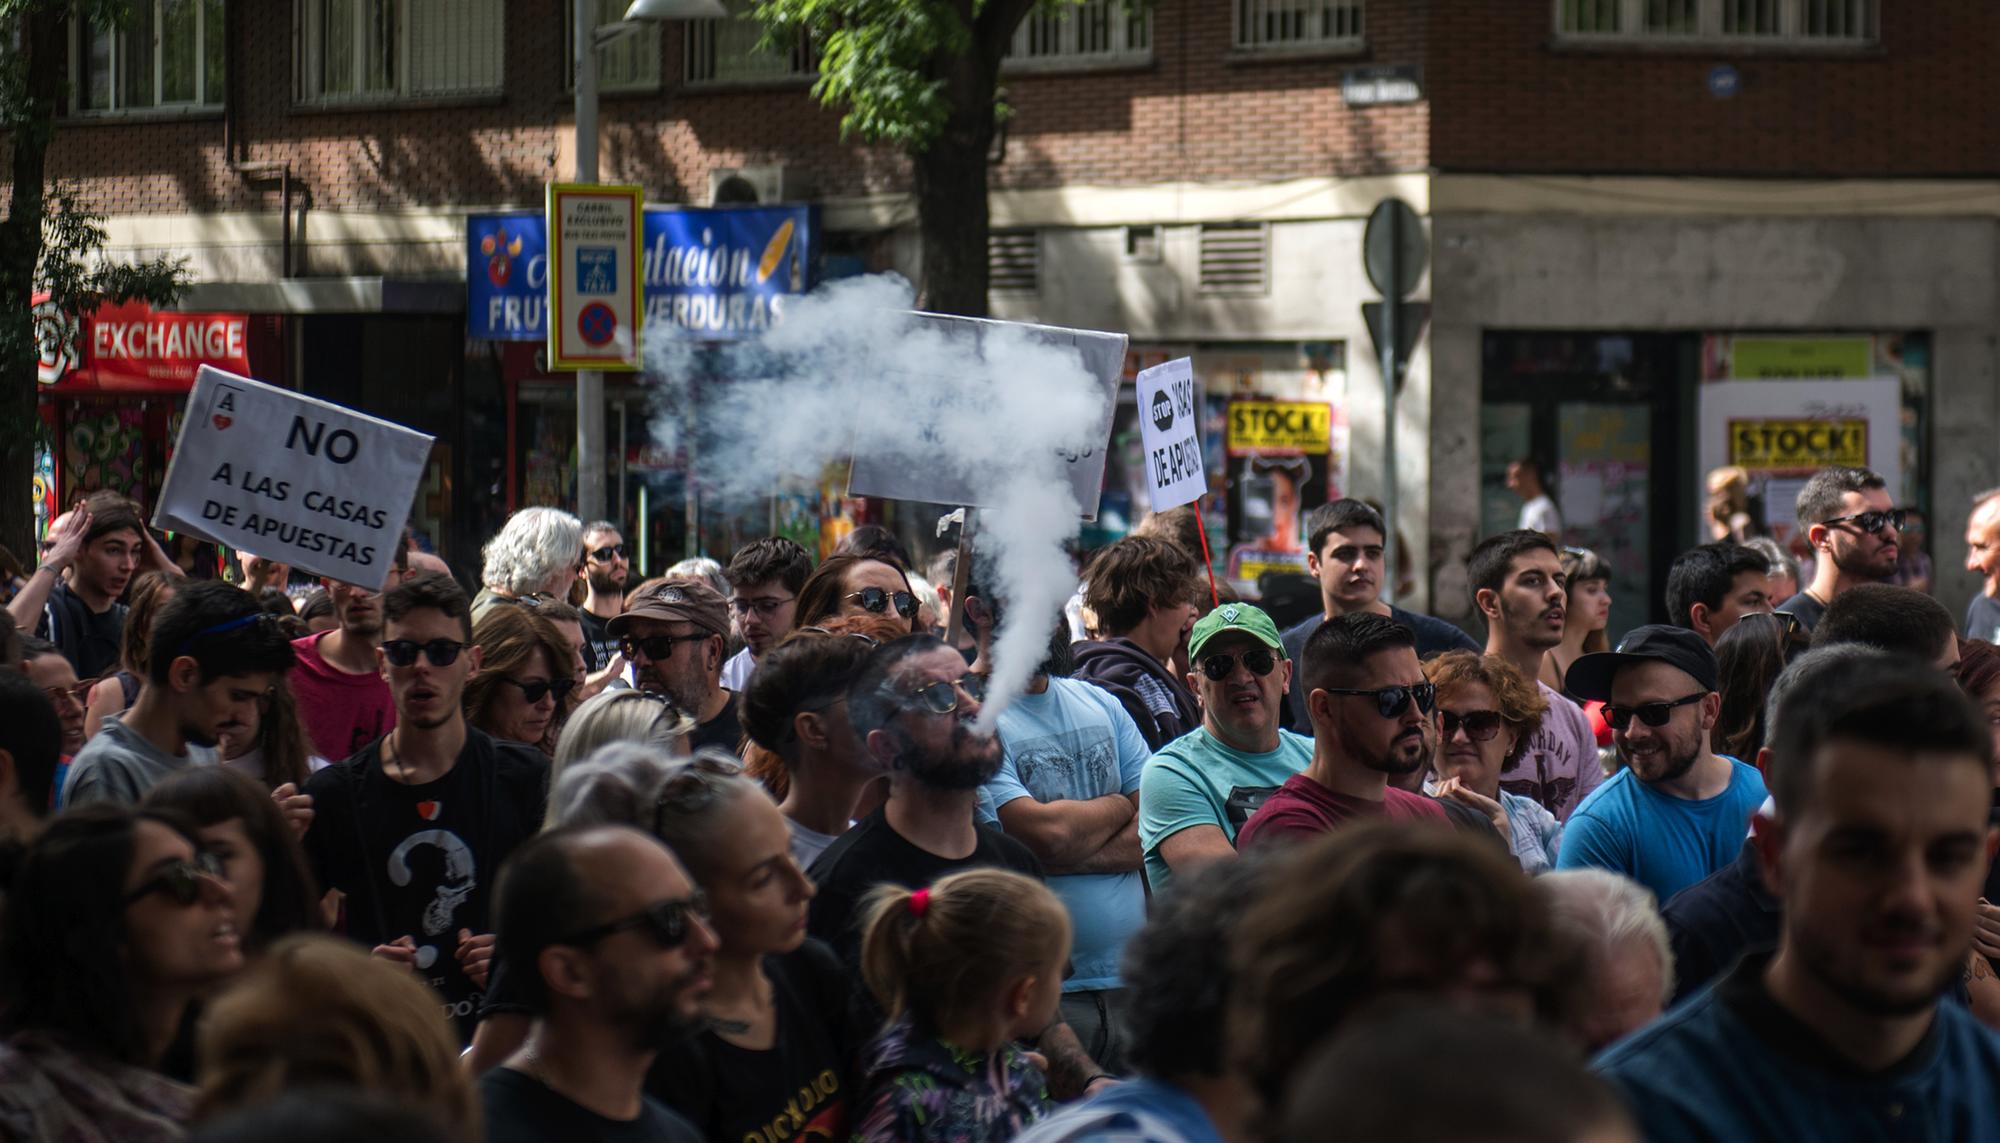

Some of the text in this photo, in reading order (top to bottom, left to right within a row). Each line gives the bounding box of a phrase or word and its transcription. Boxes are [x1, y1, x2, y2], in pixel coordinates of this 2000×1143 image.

[489, 295, 547, 331] FRU
[93, 320, 244, 360] EXCHANGE
[217, 392, 235, 412] A
[1153, 399, 1173, 423] STOP
[285, 415, 360, 465] NO
[1738, 428, 1860, 455] STOCK!
[1153, 447, 1171, 489] DE
[211, 462, 388, 530] A LAS CASAS
[201, 499, 376, 566] DE APUESTAS
[1530, 727, 1571, 767] URDAY
